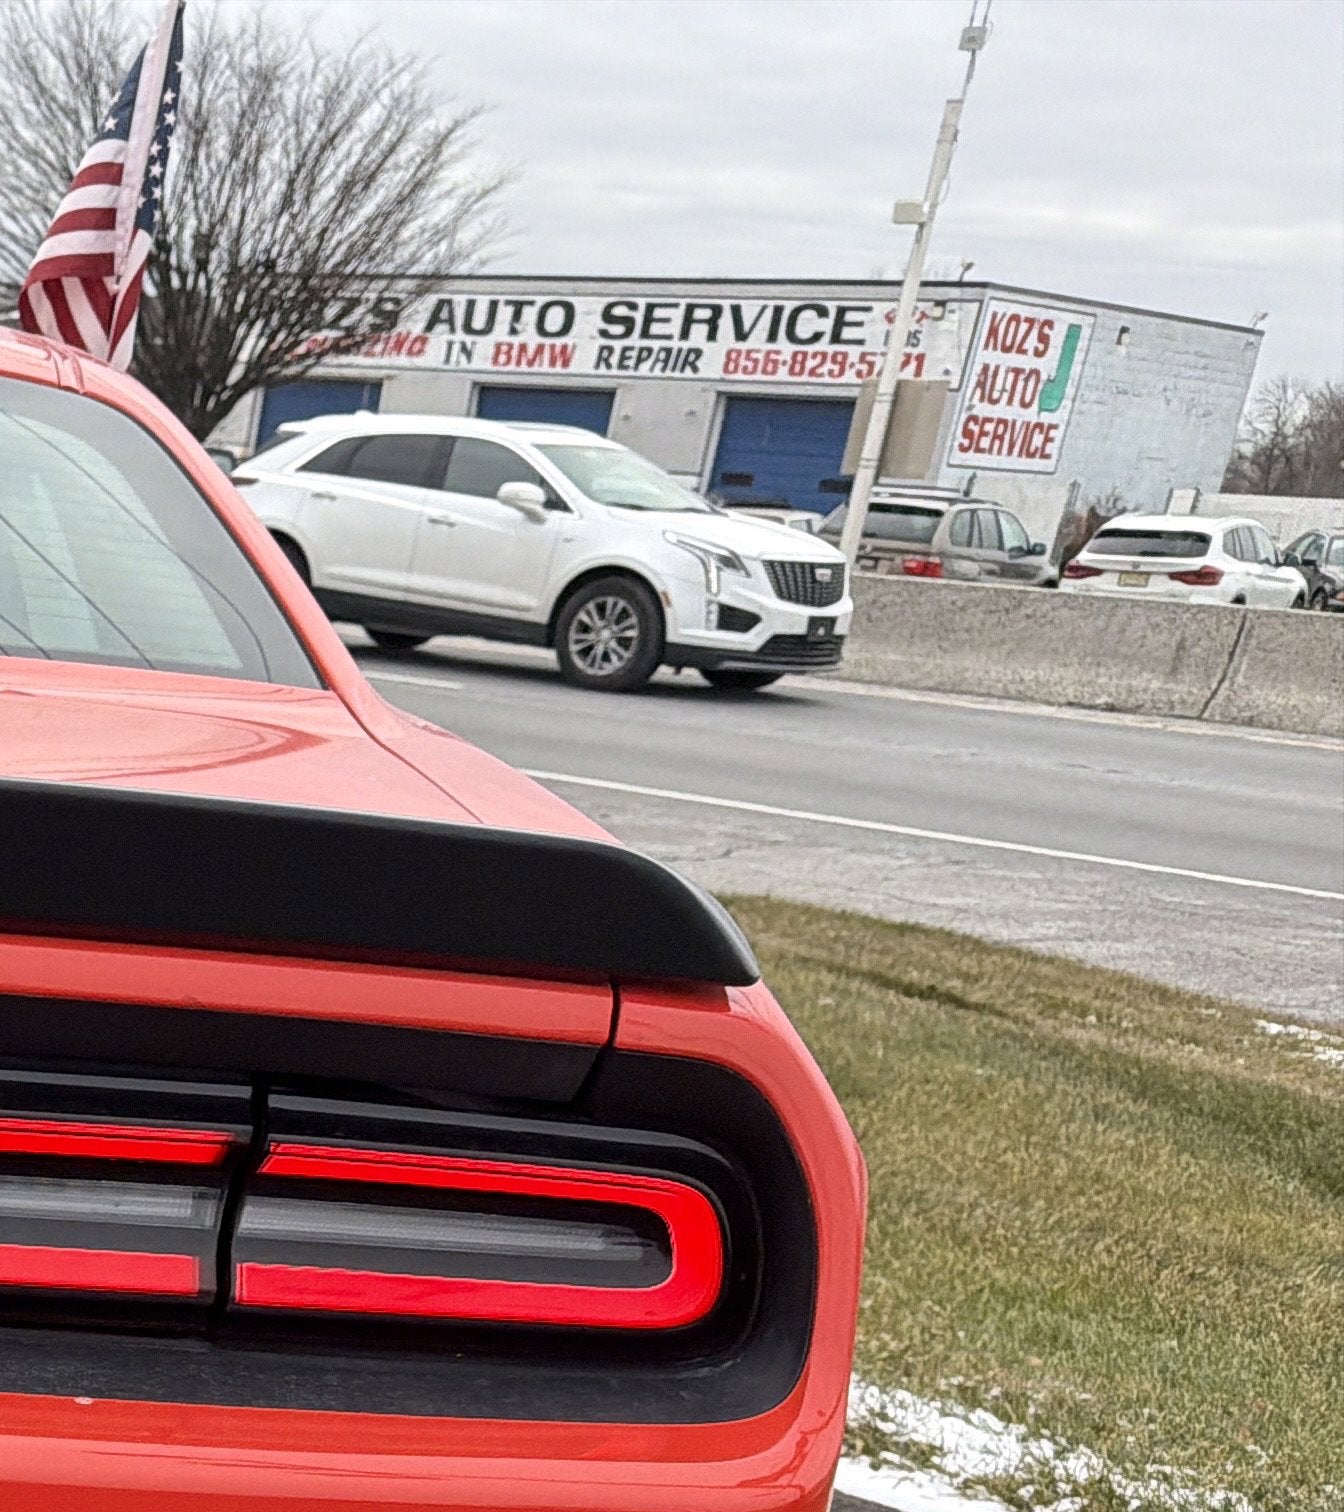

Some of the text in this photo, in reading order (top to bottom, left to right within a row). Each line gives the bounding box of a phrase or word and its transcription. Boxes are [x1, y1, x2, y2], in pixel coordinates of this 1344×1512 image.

[423, 298, 576, 338] AUTO
[597, 299, 874, 346] SERVICE
[983, 310, 1056, 359] KOZ'S
[443, 340, 477, 366] IN
[491, 341, 577, 369] BMW
[594, 345, 704, 375] REPAIR
[970, 362, 1042, 410] AUTO
[958, 414, 1060, 460] SERVICE
